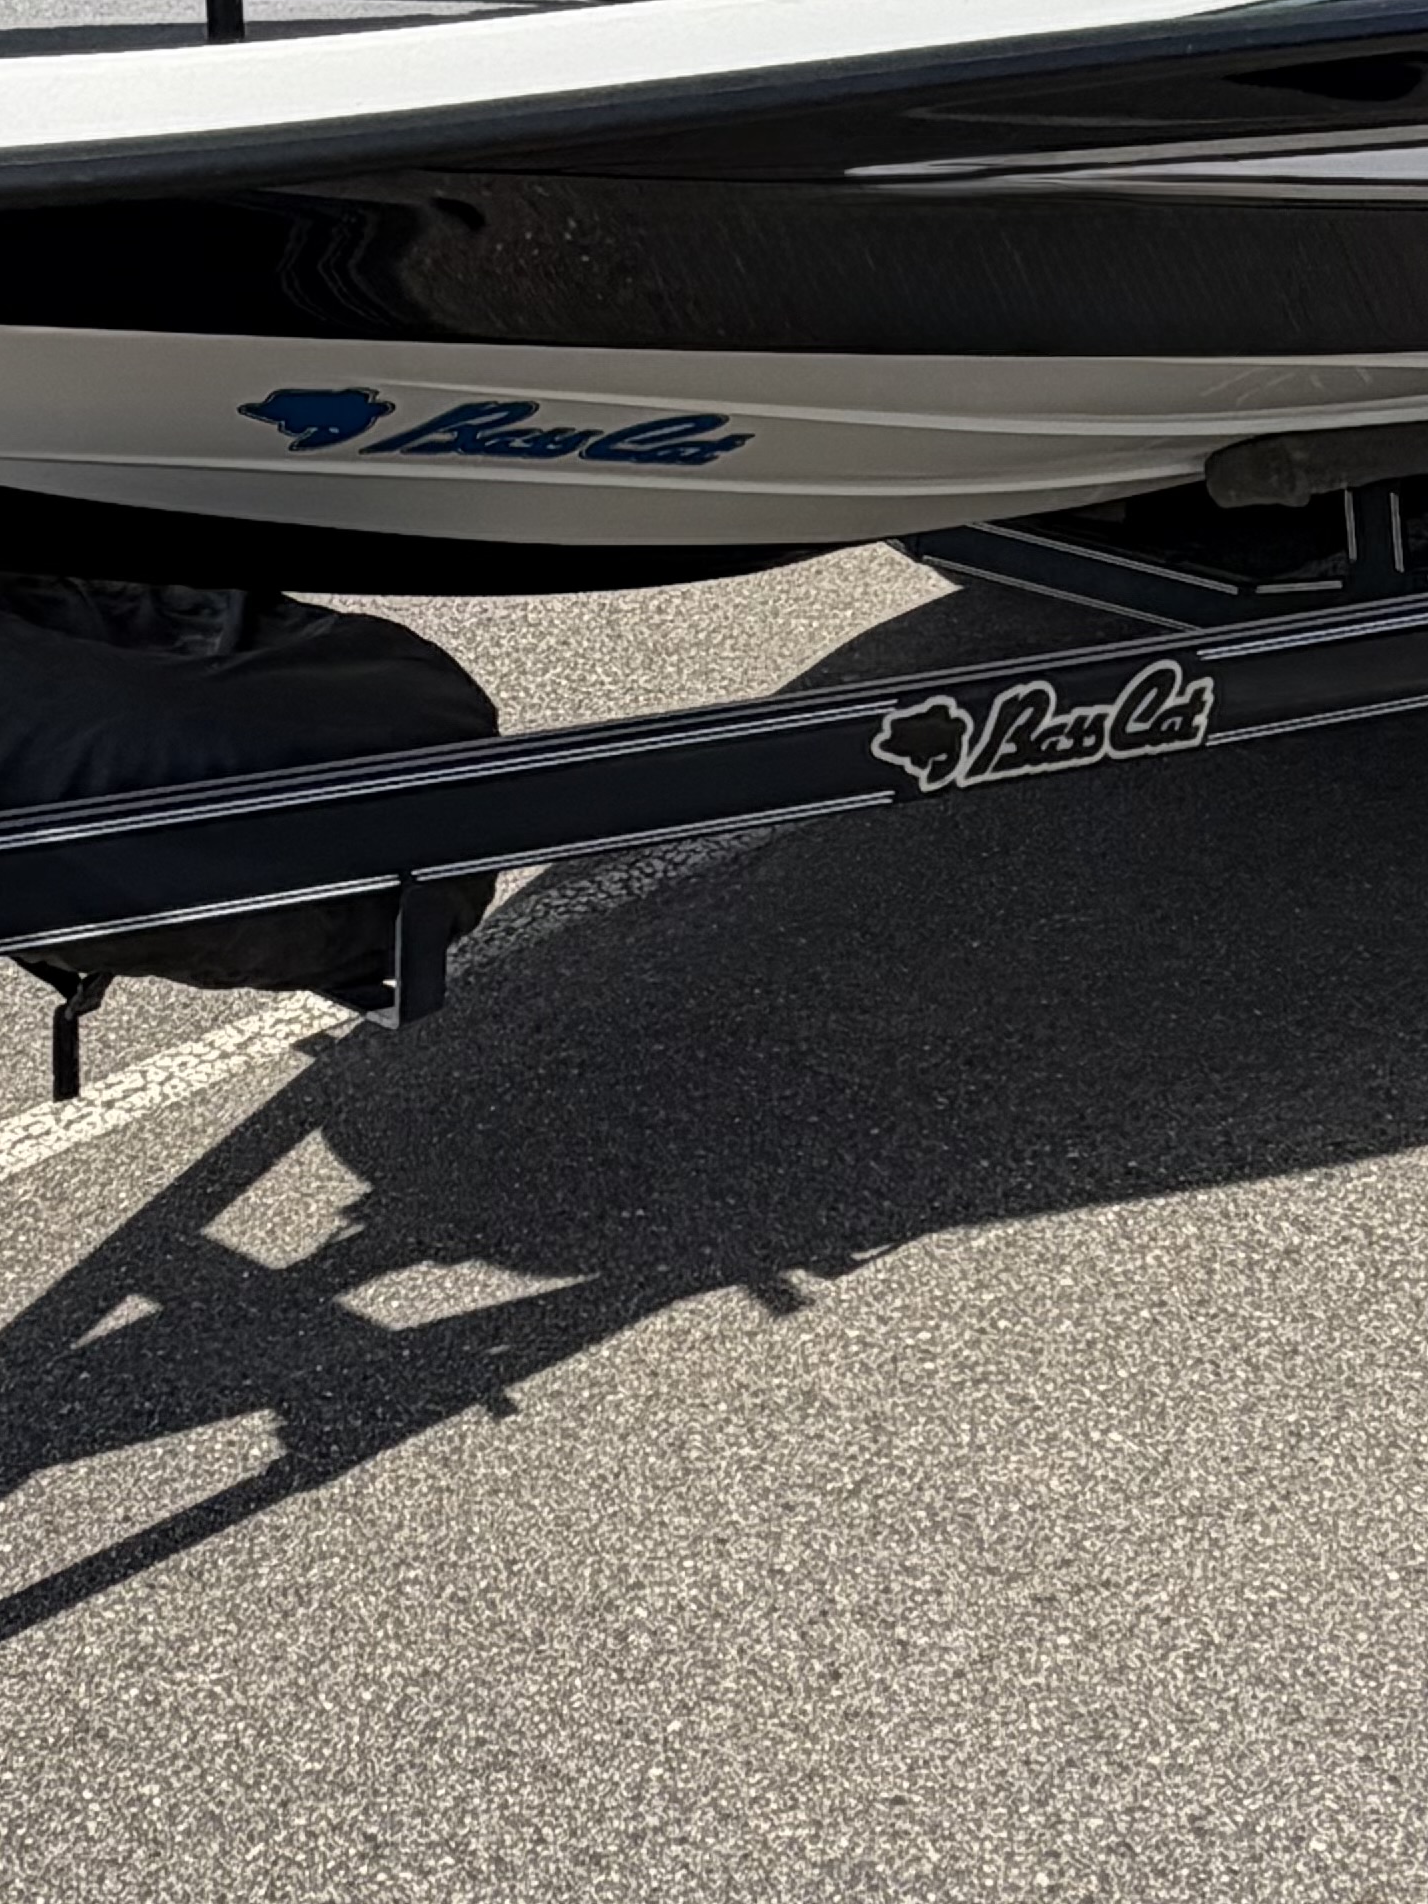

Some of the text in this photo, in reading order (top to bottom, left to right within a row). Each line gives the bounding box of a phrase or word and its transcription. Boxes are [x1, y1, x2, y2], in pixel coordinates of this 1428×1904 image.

[360, 401, 756, 465] Bass Cat
[957, 659, 1214, 788] Bass Cat
